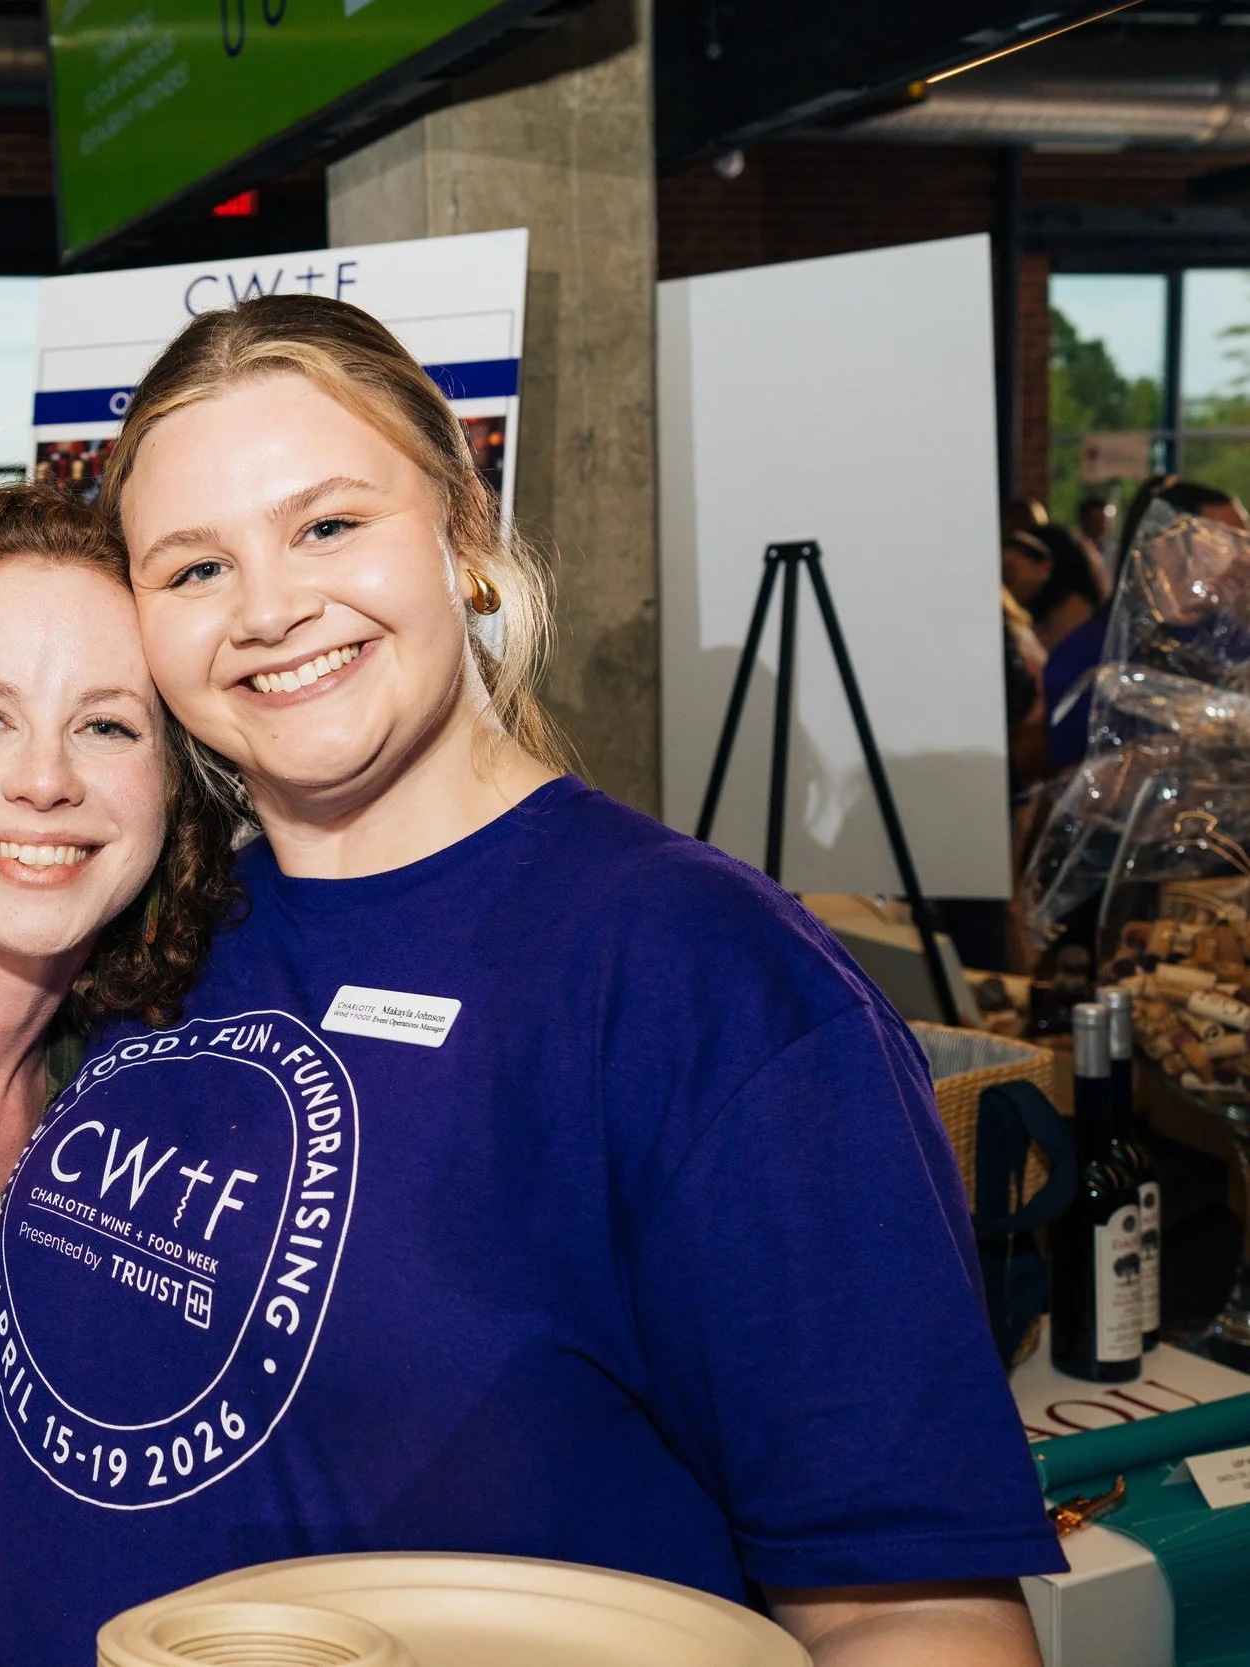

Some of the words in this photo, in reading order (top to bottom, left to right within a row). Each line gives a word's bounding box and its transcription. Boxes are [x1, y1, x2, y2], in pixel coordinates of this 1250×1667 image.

[333, 1010, 349, 1018] WINE
[353, 1013, 371, 1021] FOOD
[337, 1001, 376, 1013] CHARLOTTE
[371, 1015, 389, 1024] Event
[388, 1017, 419, 1029] Operations
[419, 1023, 447, 1034] Manager
[381, 1005, 414, 1019] Makayla
[414, 1010, 447, 1024] Johnson
[75, 1036, 180, 1094] FOOD
[209, 1023, 273, 1053] FUN
[265, 1044, 342, 1336] FUNDRAISING
[18, 1221, 84, 1260] Presented
[83, 1248, 103, 1271] by
[30, 1186, 97, 1222] CHARLOTTE
[100, 1211, 133, 1237] WINE
[135, 1229, 144, 1242] +
[147, 1233, 183, 1259] FOOD
[187, 1248, 219, 1275] WEEK
[111, 1253, 184, 1308] TRUIST
[42, 1415, 127, 1488] 15-19
[145, 1400, 246, 1487] 2026
